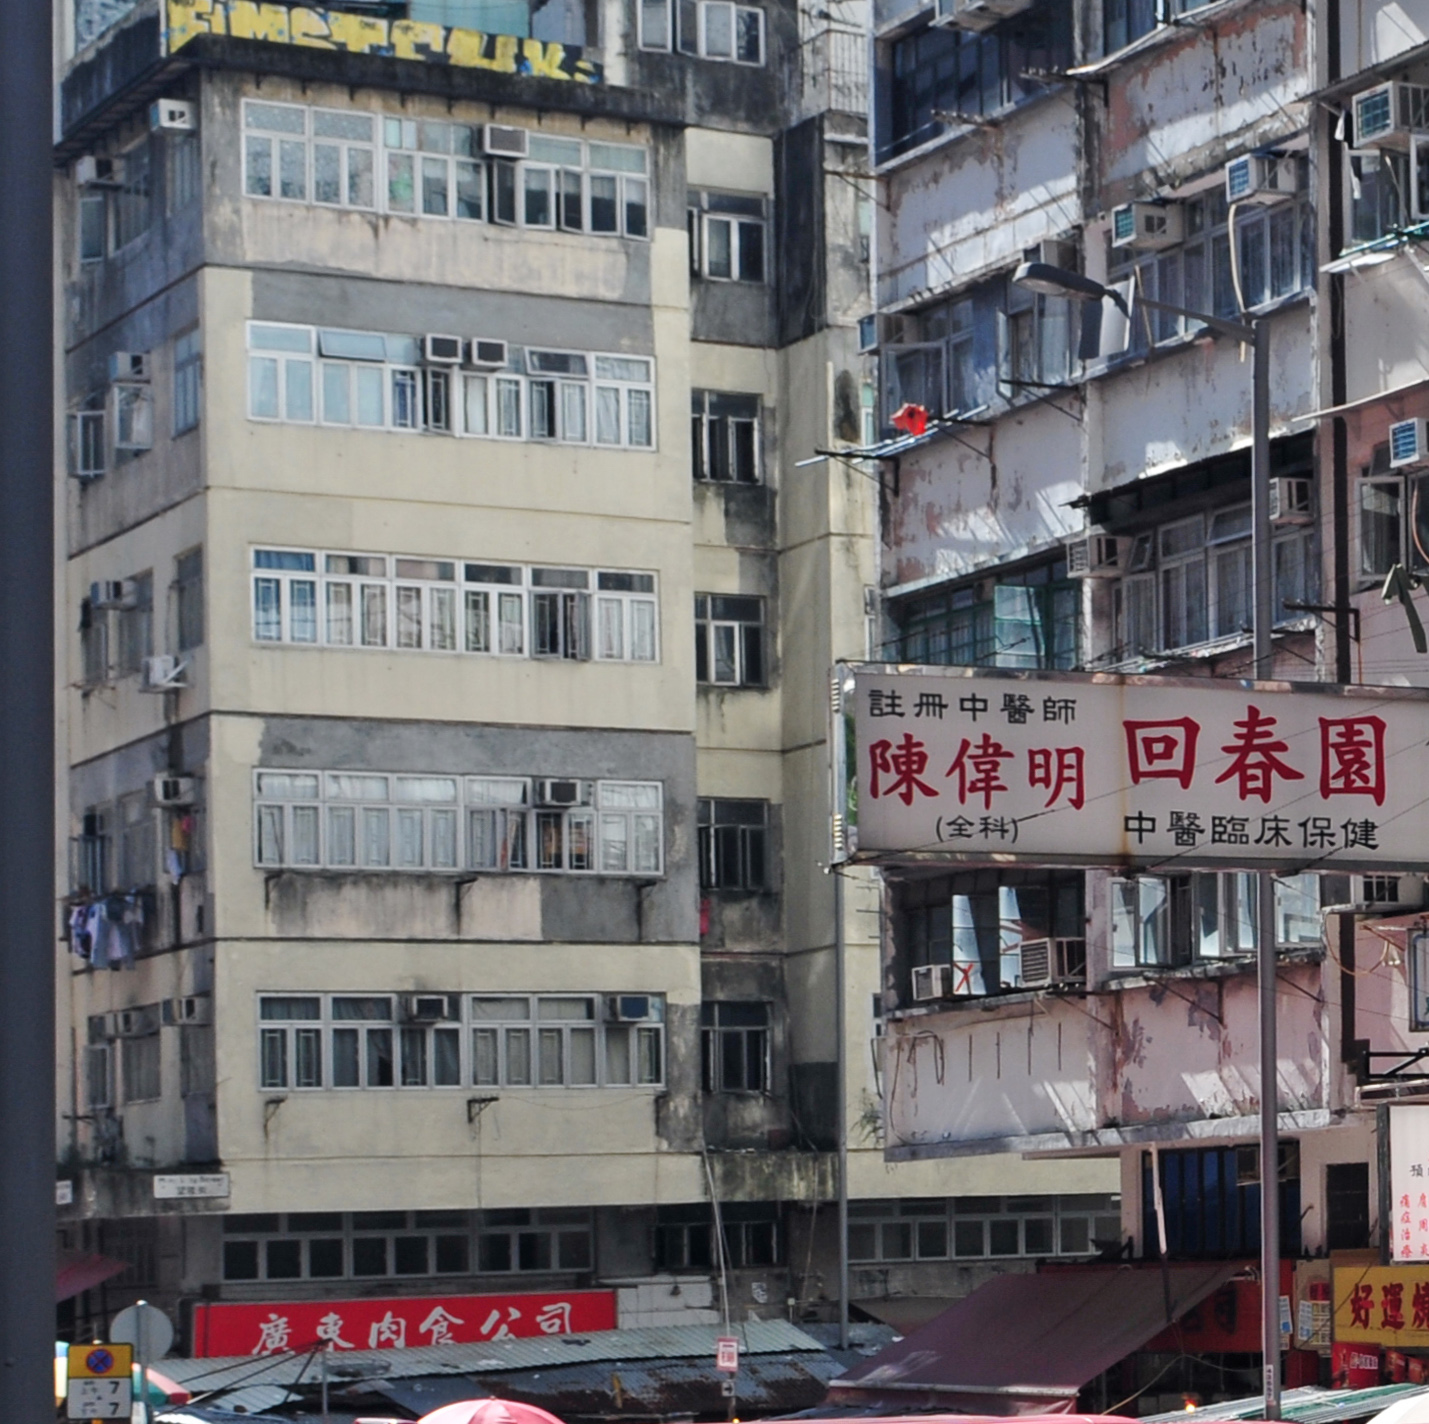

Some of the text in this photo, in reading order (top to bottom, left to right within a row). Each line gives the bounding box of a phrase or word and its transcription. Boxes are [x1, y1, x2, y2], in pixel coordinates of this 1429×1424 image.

[868, 689, 1077, 727] 註冊中醫師
[868, 737, 1086, 812] 陳偉明
[1122, 704, 1387, 808] 回春園
[935, 814, 1020, 844] (全科)
[1124, 811, 1381, 852] 中醫臨床保健
[252, 1302, 572, 1356] 廣東肉食公司
